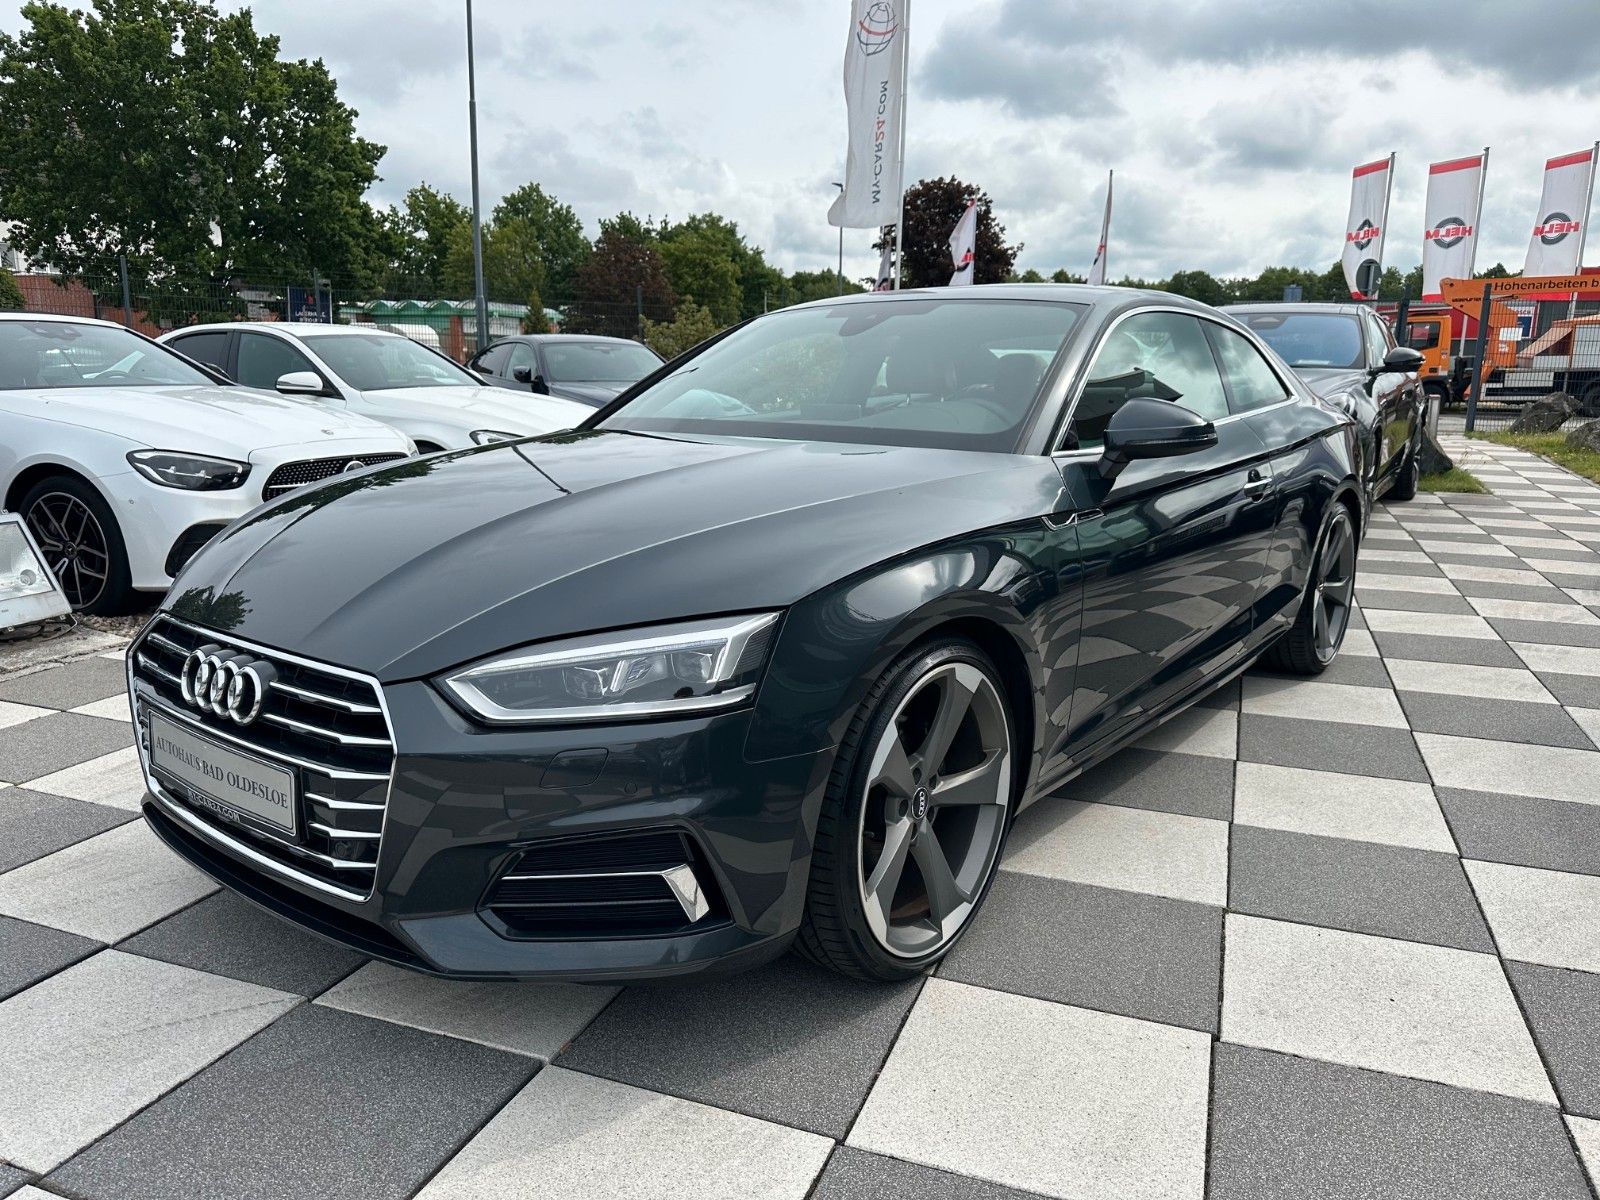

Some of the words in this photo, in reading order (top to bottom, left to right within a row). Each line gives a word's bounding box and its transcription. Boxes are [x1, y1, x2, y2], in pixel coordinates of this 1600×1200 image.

[156, 736, 201, 771] AUTOHAUS
[202, 760, 224, 781] BAD
[227, 771, 288, 809] OLDESLOE
